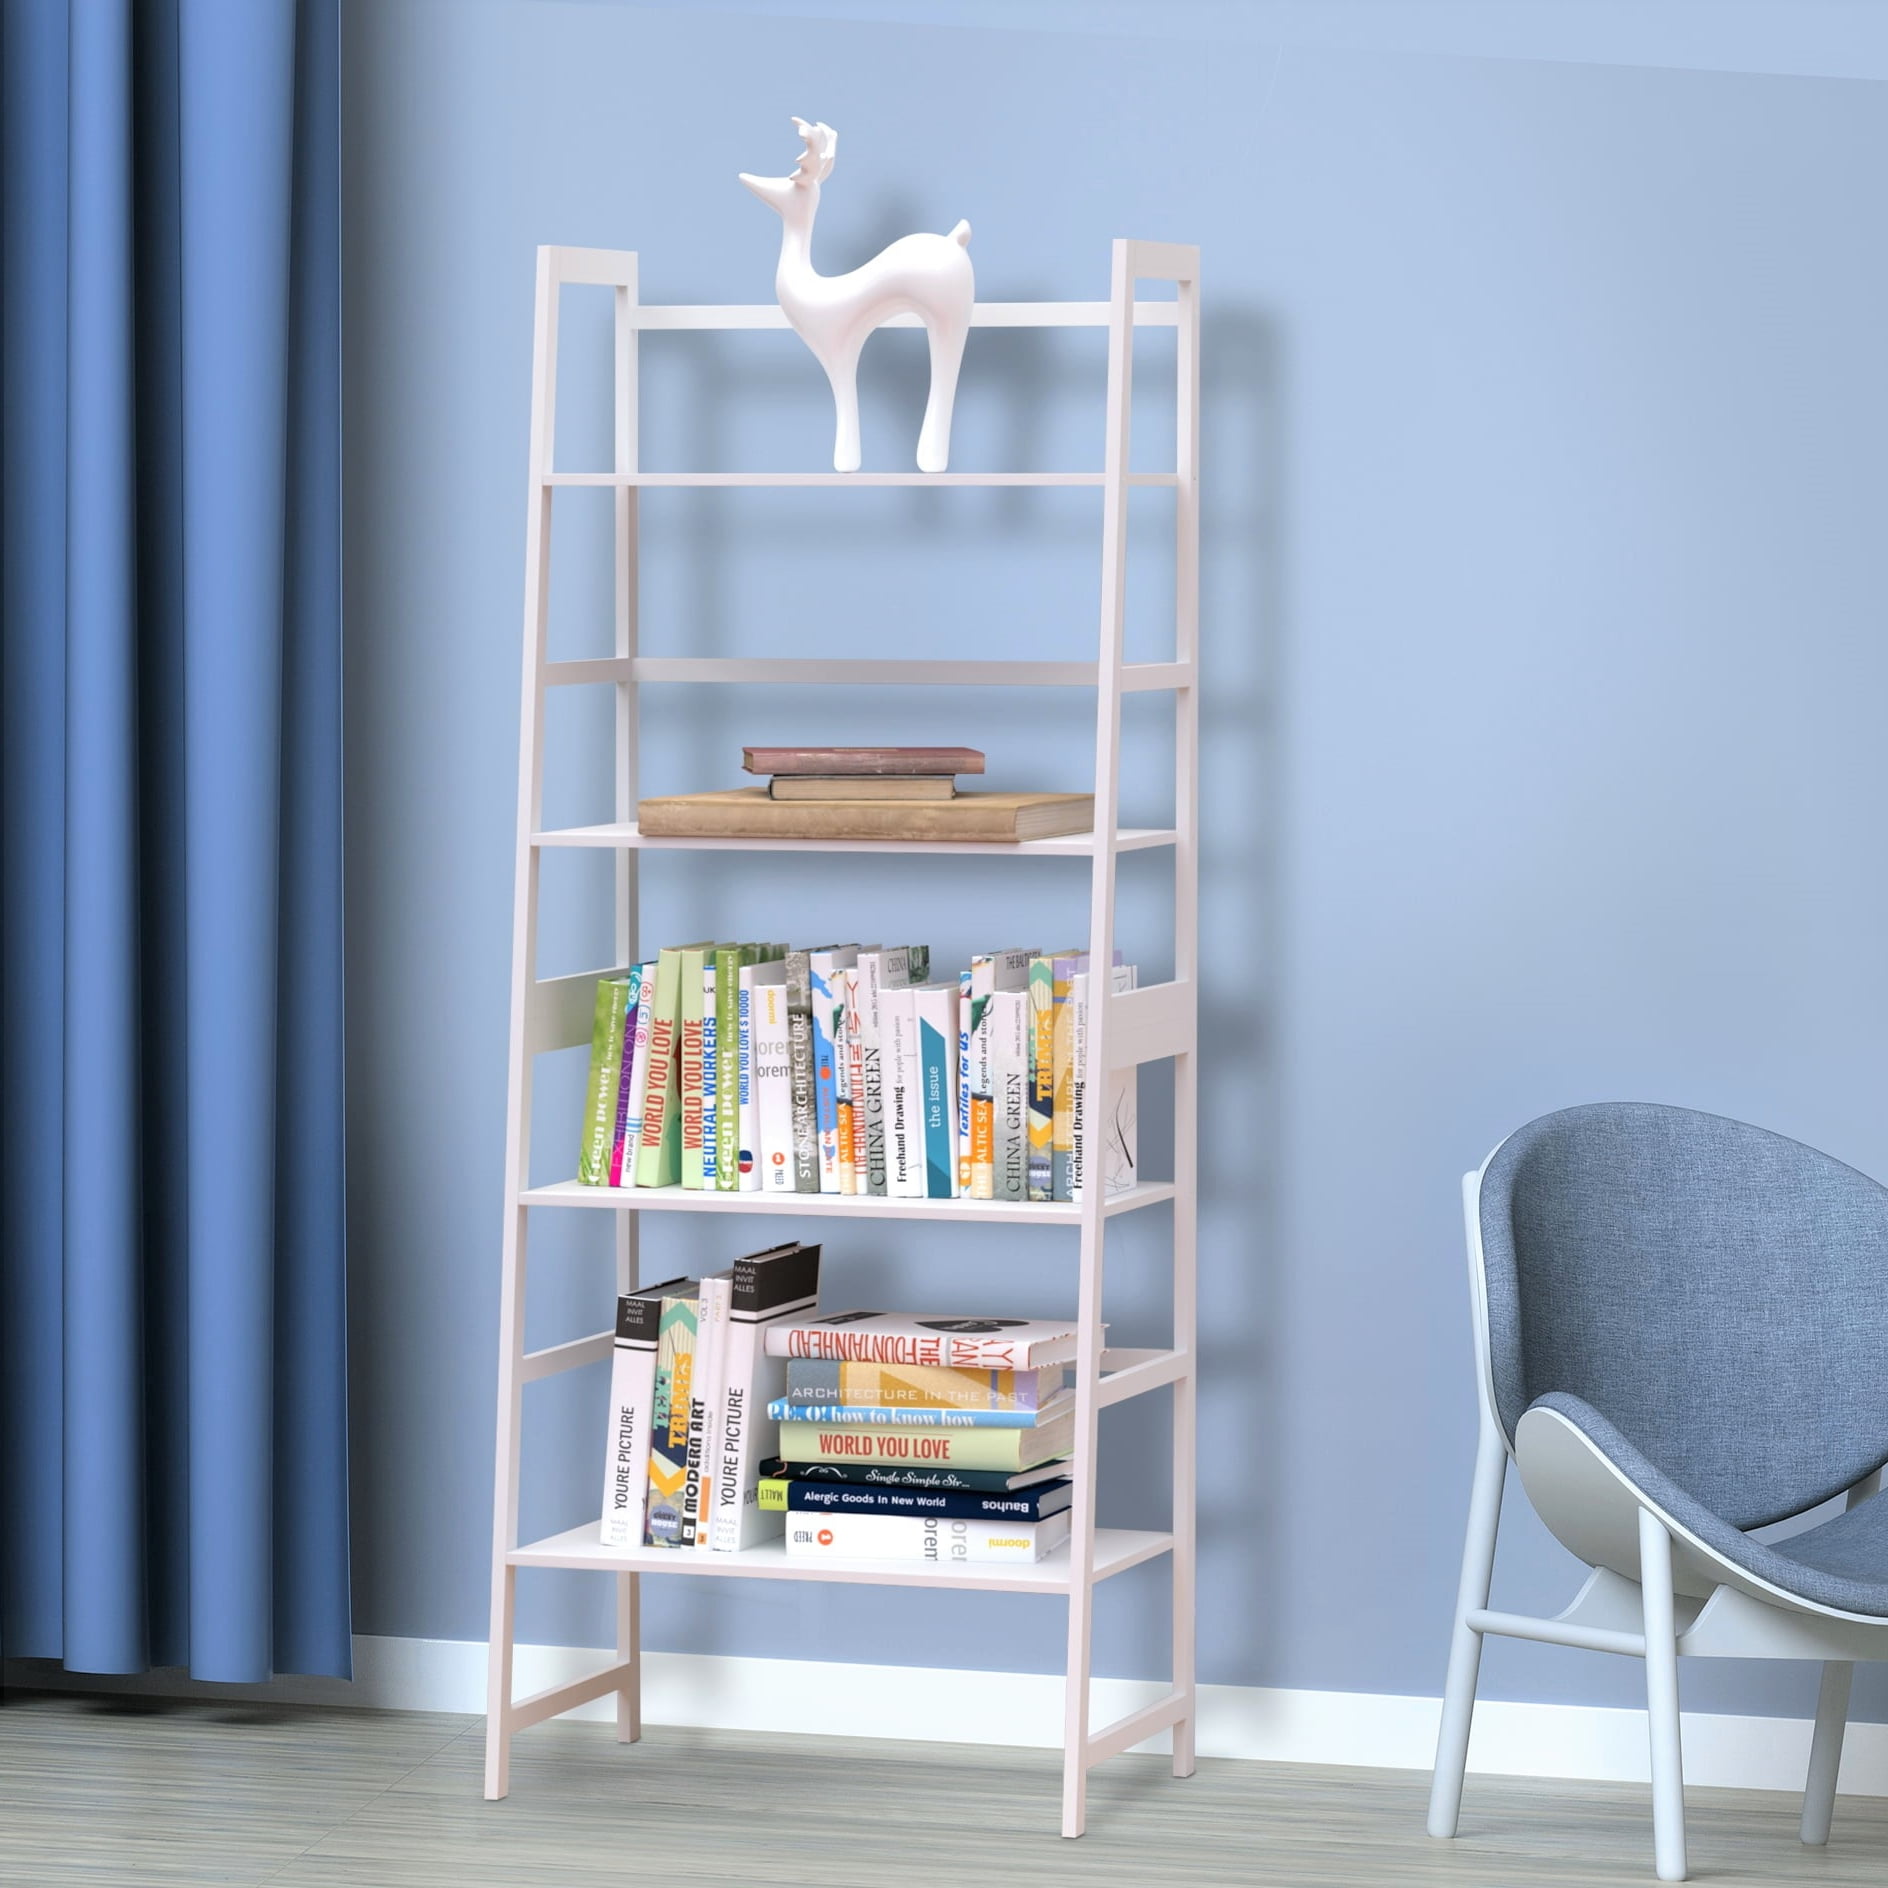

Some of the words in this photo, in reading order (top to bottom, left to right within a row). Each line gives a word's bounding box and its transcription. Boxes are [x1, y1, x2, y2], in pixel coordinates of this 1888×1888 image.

[739, 990, 749, 1017] 10000
[651, 1017, 673, 1055] LOVE
[683, 1019, 702, 1056] LOVE
[739, 1029, 749, 1051] LOVE
[979, 1037, 987, 1055] and
[647, 1058, 669, 1090] YOU
[703, 1017, 716, 1096] WORKERS
[739, 1052, 749, 1070] YOU
[793, 1013, 809, 1127] ARCHITECTURE
[960, 1056, 969, 1078] for
[683, 1060, 702, 1092] YOU
[739, 1073, 749, 1105] WORLD
[865, 1048, 882, 1113] GREEN
[929, 1066, 940, 1101] issue
[979, 1057, 989, 1094] Legends
[894, 1086, 905, 1130] Drawing
[930, 1105, 941, 1128] the
[959, 1083, 969, 1136] Textiles
[976, 1099, 988, 1123] SEA
[1006, 1073, 1020, 1130] GREEN
[1073, 1082, 1086, 1130] Drawing
[641, 1094, 664, 1147] WORLD
[683, 1096, 702, 1150] WORLD
[703, 1103, 716, 1177] NEUTRAL
[798, 1128, 811, 1178] STONE
[868, 1120, 884, 1186] CHINA
[896, 1134, 907, 1182] Freehand
[1006, 1136, 1020, 1192] CHINA
[1073, 1134, 1083, 1190] Freehand
[734, 1284, 755, 1293] ALLES
[735, 1265, 757, 1275] MAAL
[625, 1316, 644, 1325] ALLES
[626, 1300, 645, 1309] MAAL
[789, 1329, 917, 1366] FOUNTAINHEAD
[919, 1337, 941, 1367] THE
[791, 1387, 918, 1401] ARCHITECTURE
[925, 1391, 941, 1401] IN
[949, 1392, 979, 1401] THE
[987, 1392, 1028, 1402] PAST
[690, 1398, 704, 1431] ART
[725, 1387, 743, 1452] PICTURE
[831, 1407, 864, 1423] how
[869, 1408, 887, 1424] to
[891, 1407, 937, 1425] know
[941, 1410, 976, 1427] how
[618, 1406, 634, 1463] PICTURE
[819, 1434, 872, 1456] WORLD
[877, 1437, 909, 1458] YOU
[913, 1438, 950, 1460] LOVE
[614, 1465, 630, 1510] YOURE
[684, 1437, 703, 1513] MODERN
[720, 1456, 739, 1507] YOURE
[865, 1469, 900, 1484] Single
[901, 1471, 941, 1488] Simple
[804, 1491, 839, 1505] Alergic
[841, 1493, 874, 1504] Goods
[877, 1495, 888, 1504] In
[891, 1496, 914, 1505] New
[917, 1496, 946, 1507] World
